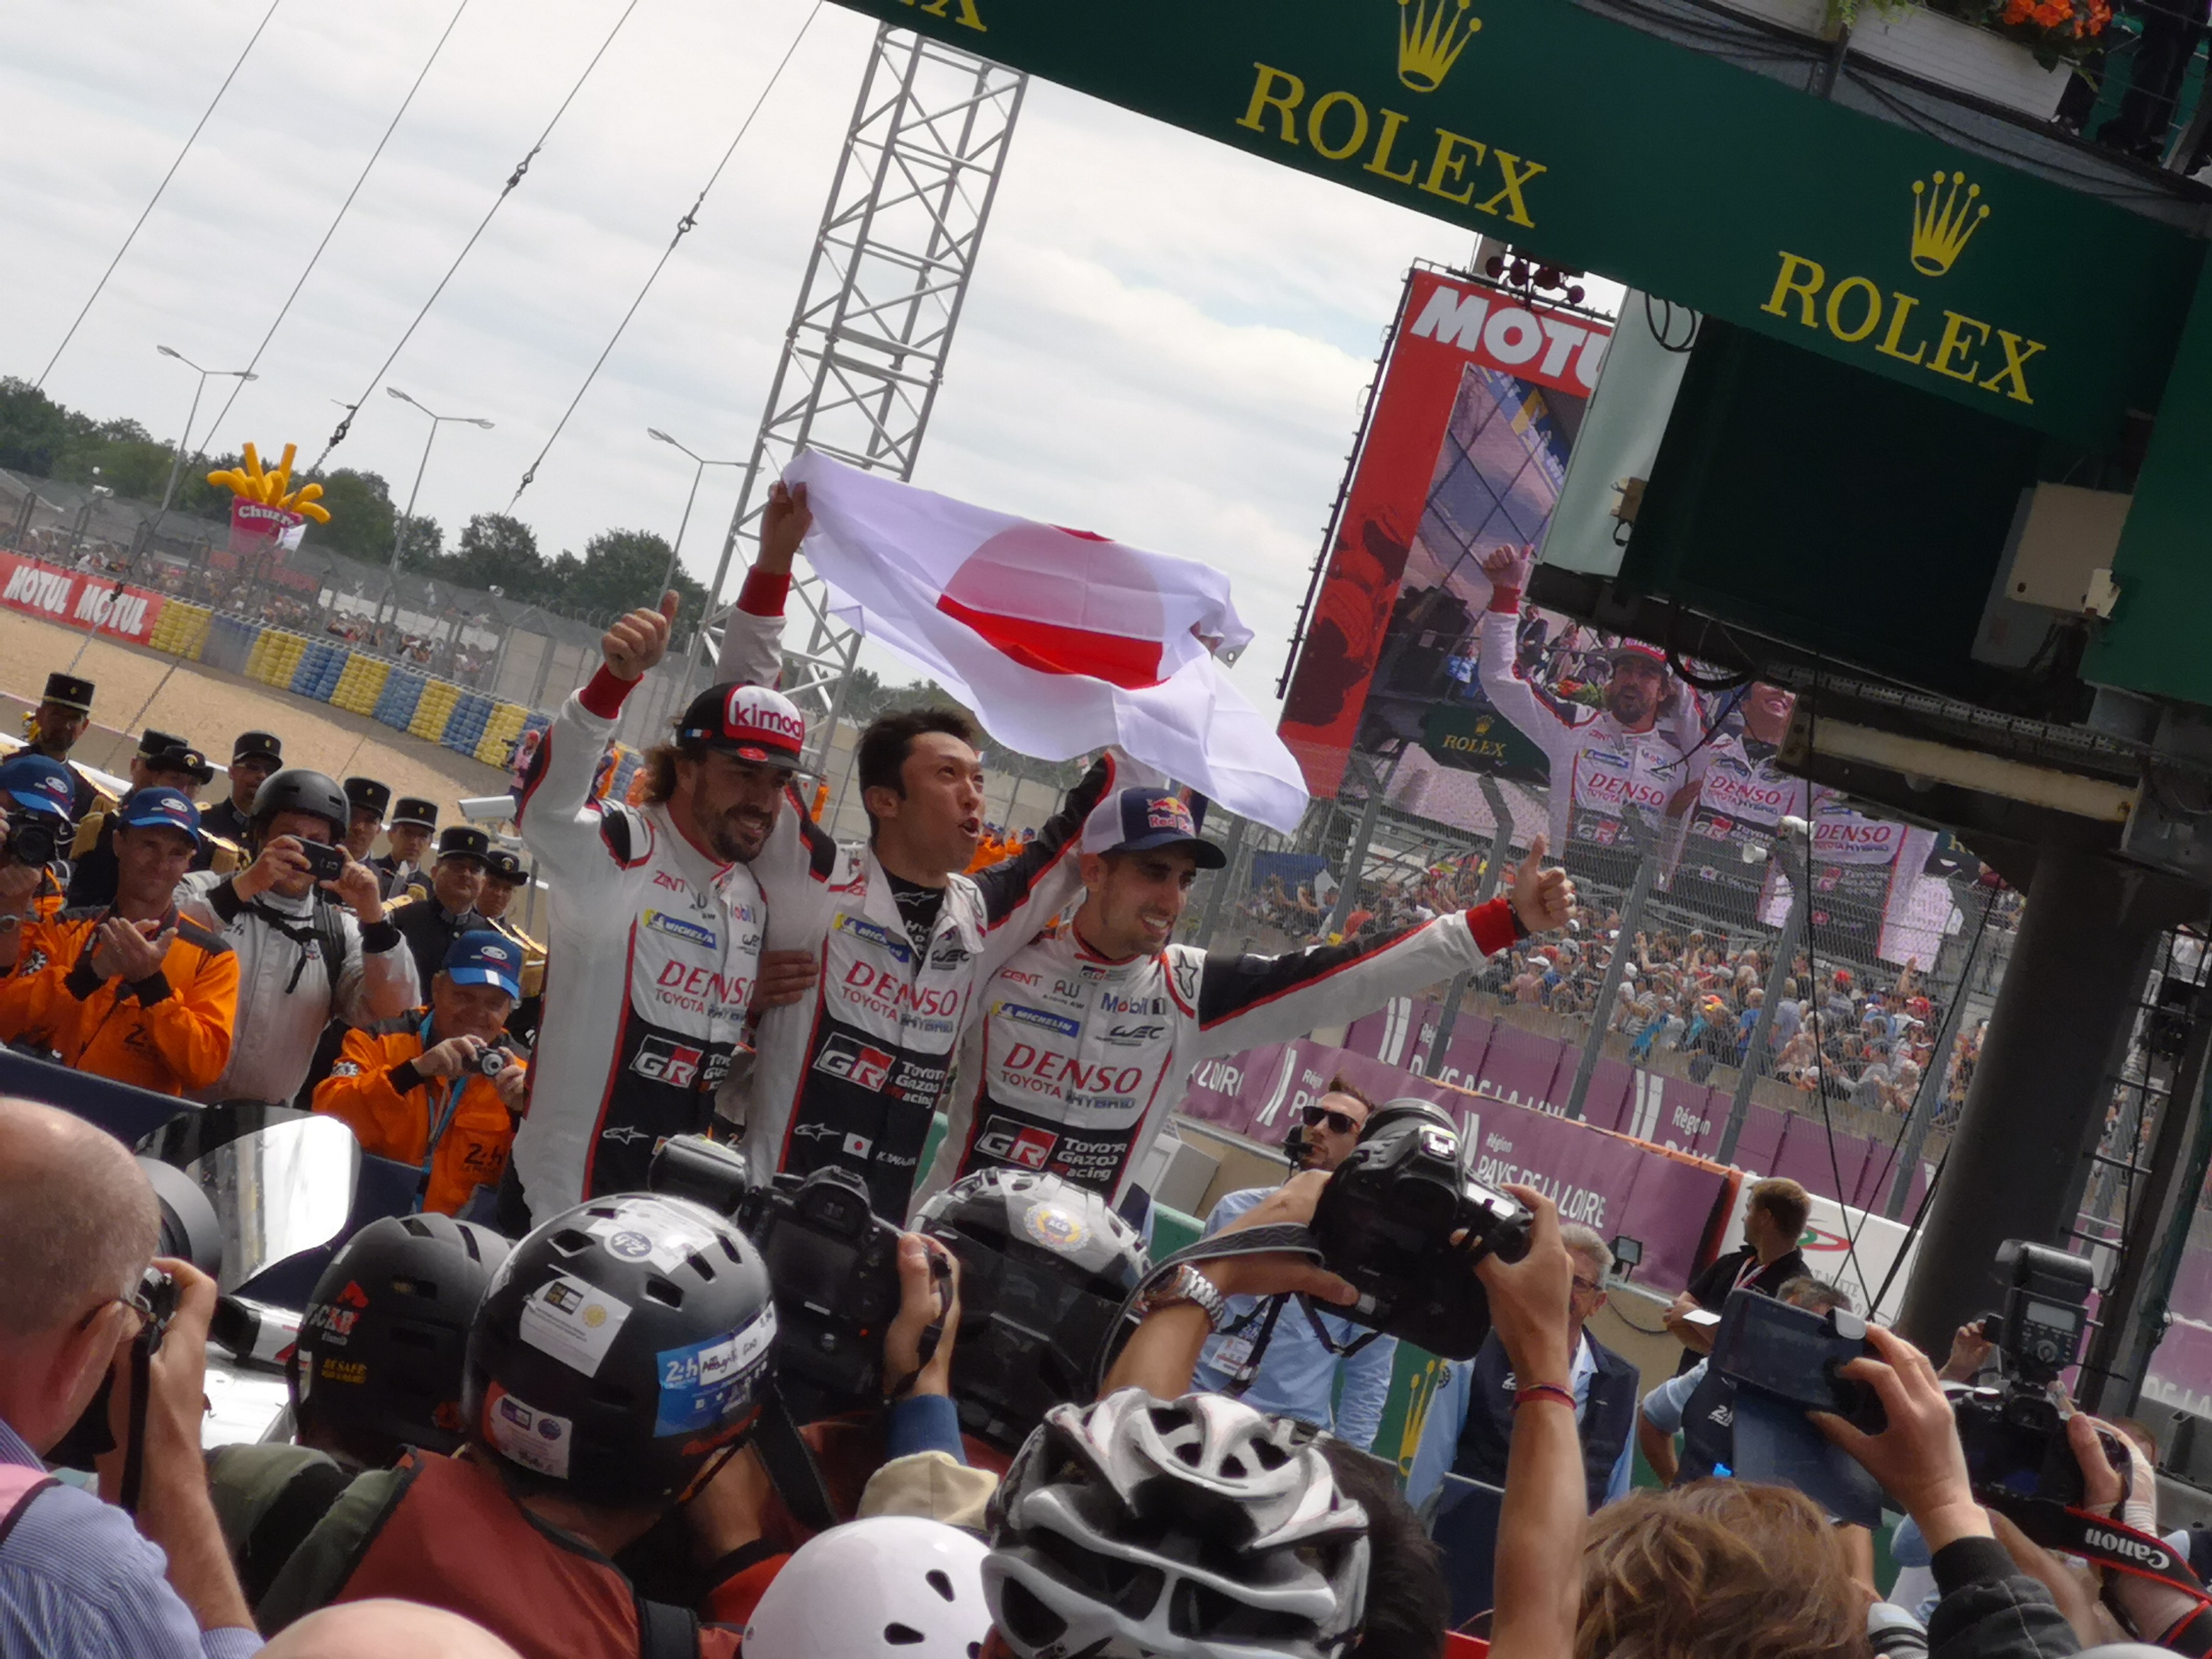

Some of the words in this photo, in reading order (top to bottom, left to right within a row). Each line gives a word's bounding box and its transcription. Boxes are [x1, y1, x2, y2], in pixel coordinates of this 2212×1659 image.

[1236, 61, 1547, 229] ROLEX
[1760, 250, 2047, 405] ROLEX
[2, 565, 73, 615] MOTUL
[73, 584, 148, 635] MOTUL
[1443, 734, 1507, 757] ROLEX
[1587, 773, 1665, 806] DENSO
[1709, 776, 1781, 805] DENSO
[1148, 814, 1176, 828] Red
[1814, 823, 1891, 843] DENSO
[845, 959, 959, 1017] DENSO
[1000, 969, 1043, 987] ZENT
[655, 989, 705, 1015] TOYOTA
[842, 986, 898, 1022] TOYOTA
[1101, 992, 1147, 1015] Mobil
[1014, 1011, 1072, 1032] MICHELIN
[1109, 1025, 1165, 1040] WEC
[635, 1052, 695, 1085] GR
[819, 1050, 886, 1088] GR
[1000, 1070, 1062, 1099] TOYOTA
[1002, 1042, 1143, 1094] DENSO
[979, 1131, 1049, 1167] GR
[1558, 1185, 1606, 1228] LOIRE
[2085, 1528, 2170, 1570] Canon
